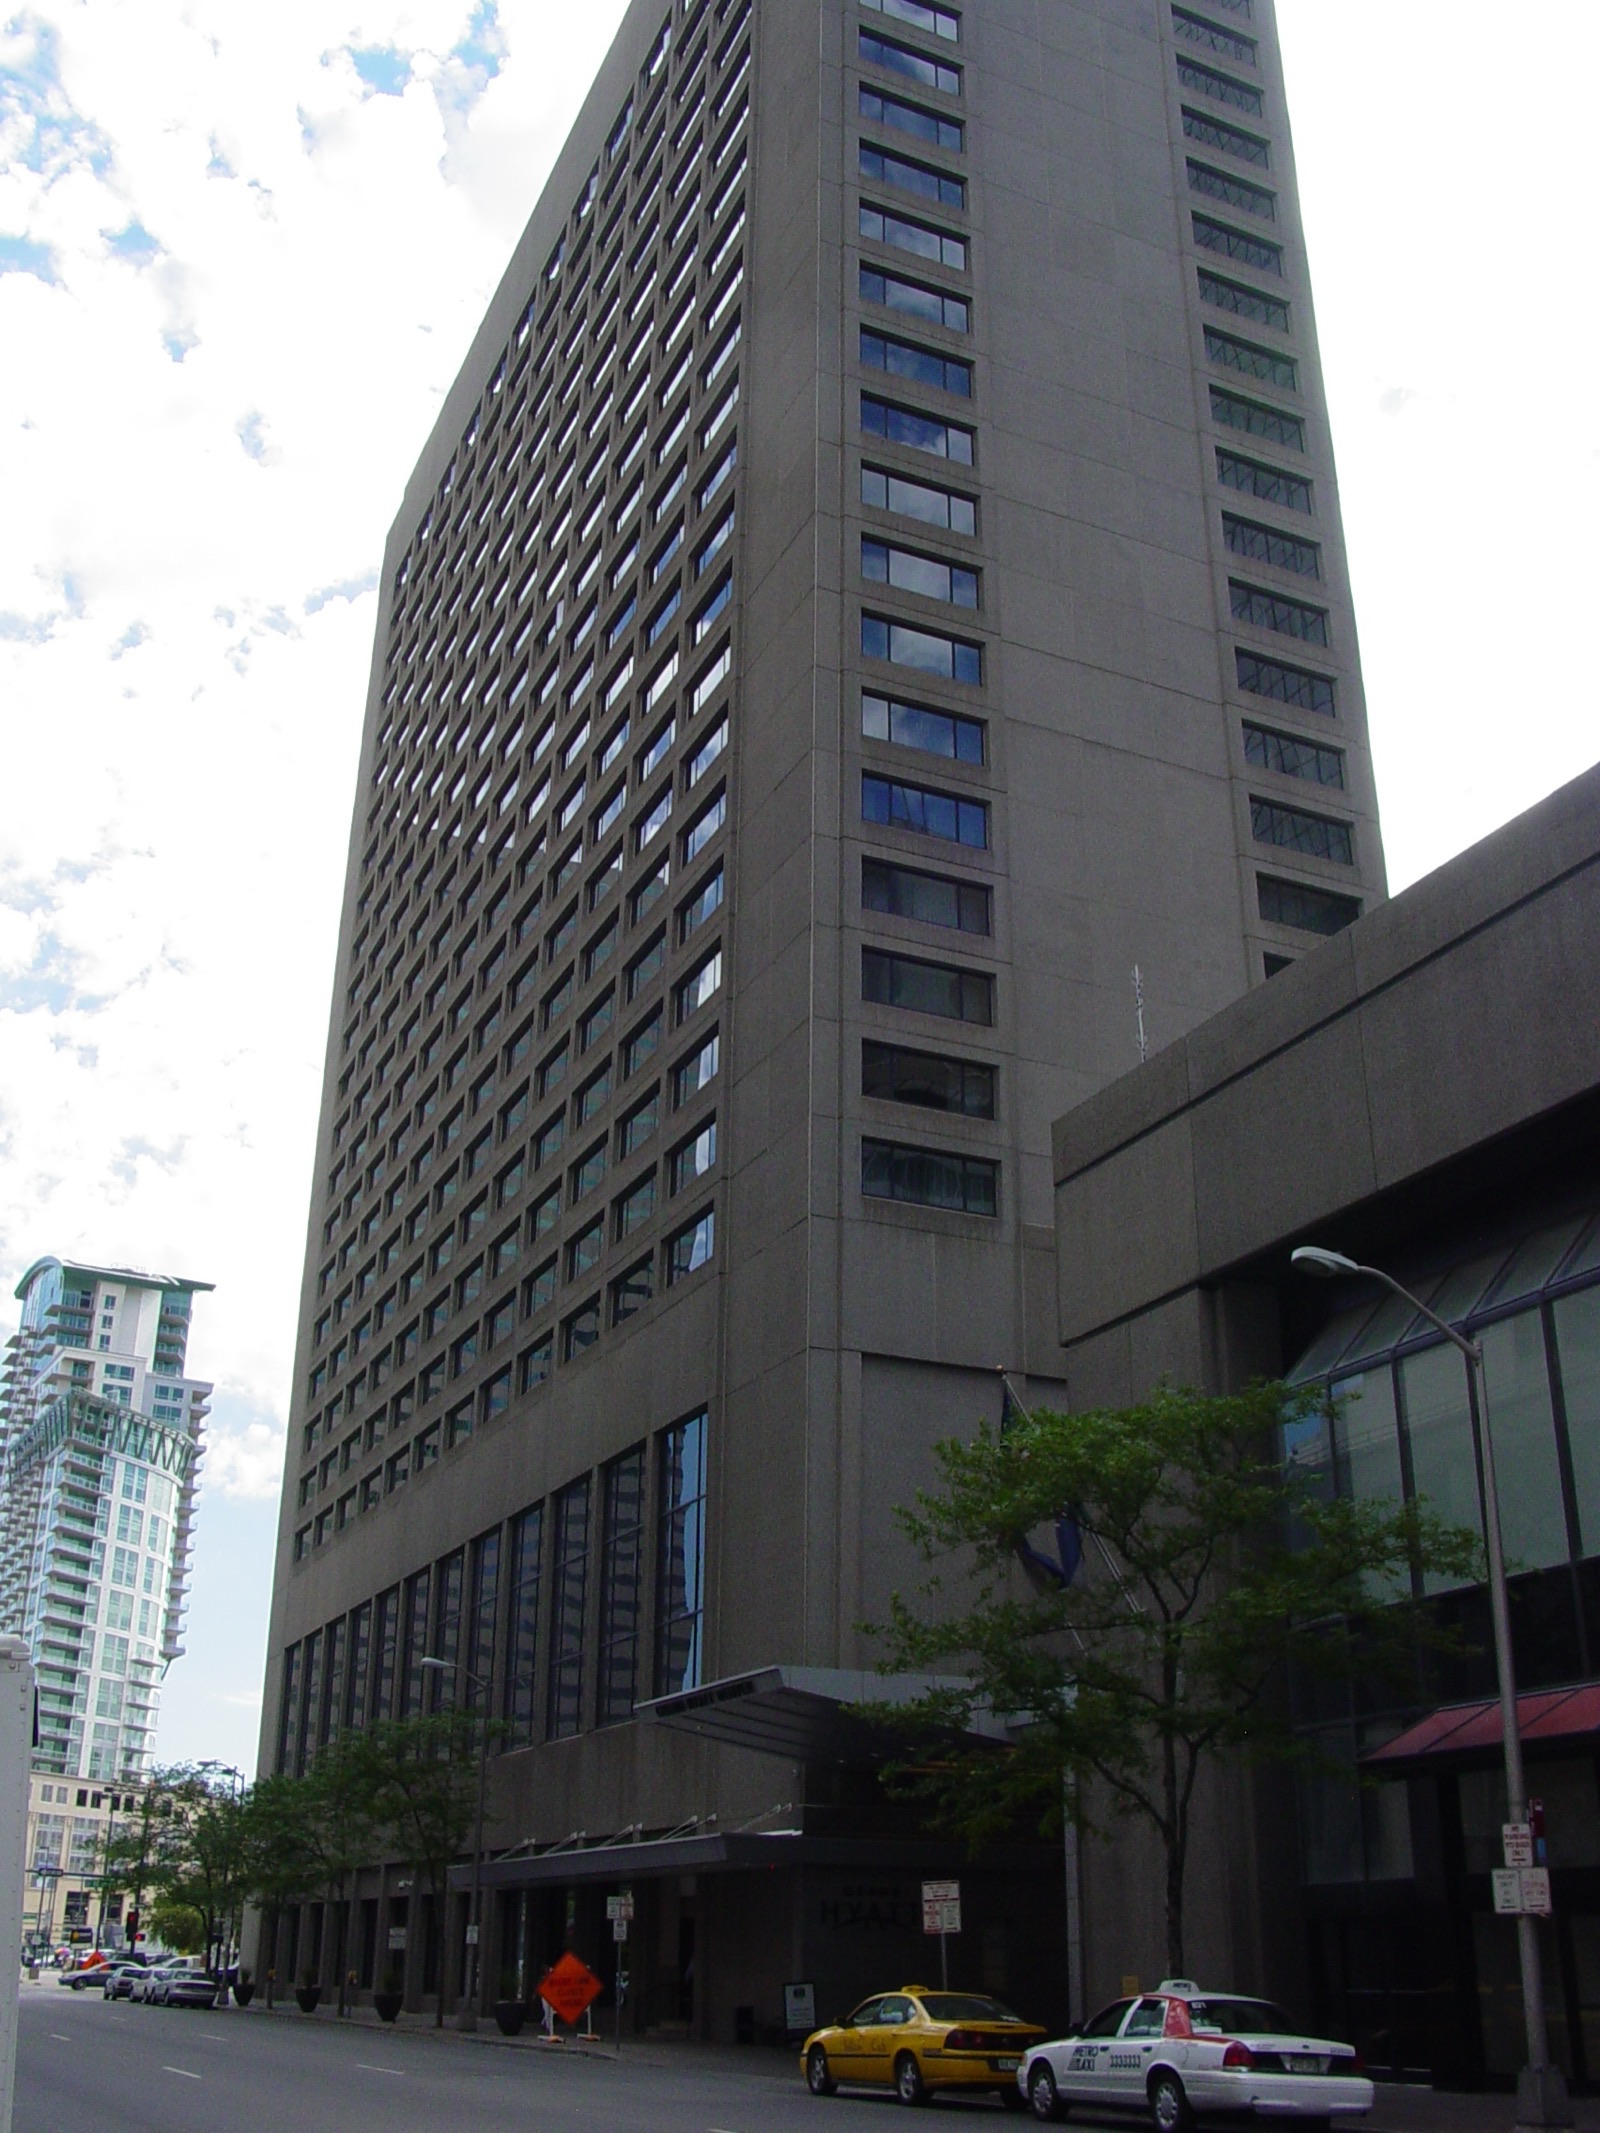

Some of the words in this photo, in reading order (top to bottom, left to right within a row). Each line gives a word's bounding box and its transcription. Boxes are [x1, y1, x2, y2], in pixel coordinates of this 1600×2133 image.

[820, 1900, 920, 1930] HYATT
[1073, 2045, 1098, 2057] METRO
[1070, 2058, 1095, 2071] TAXI
